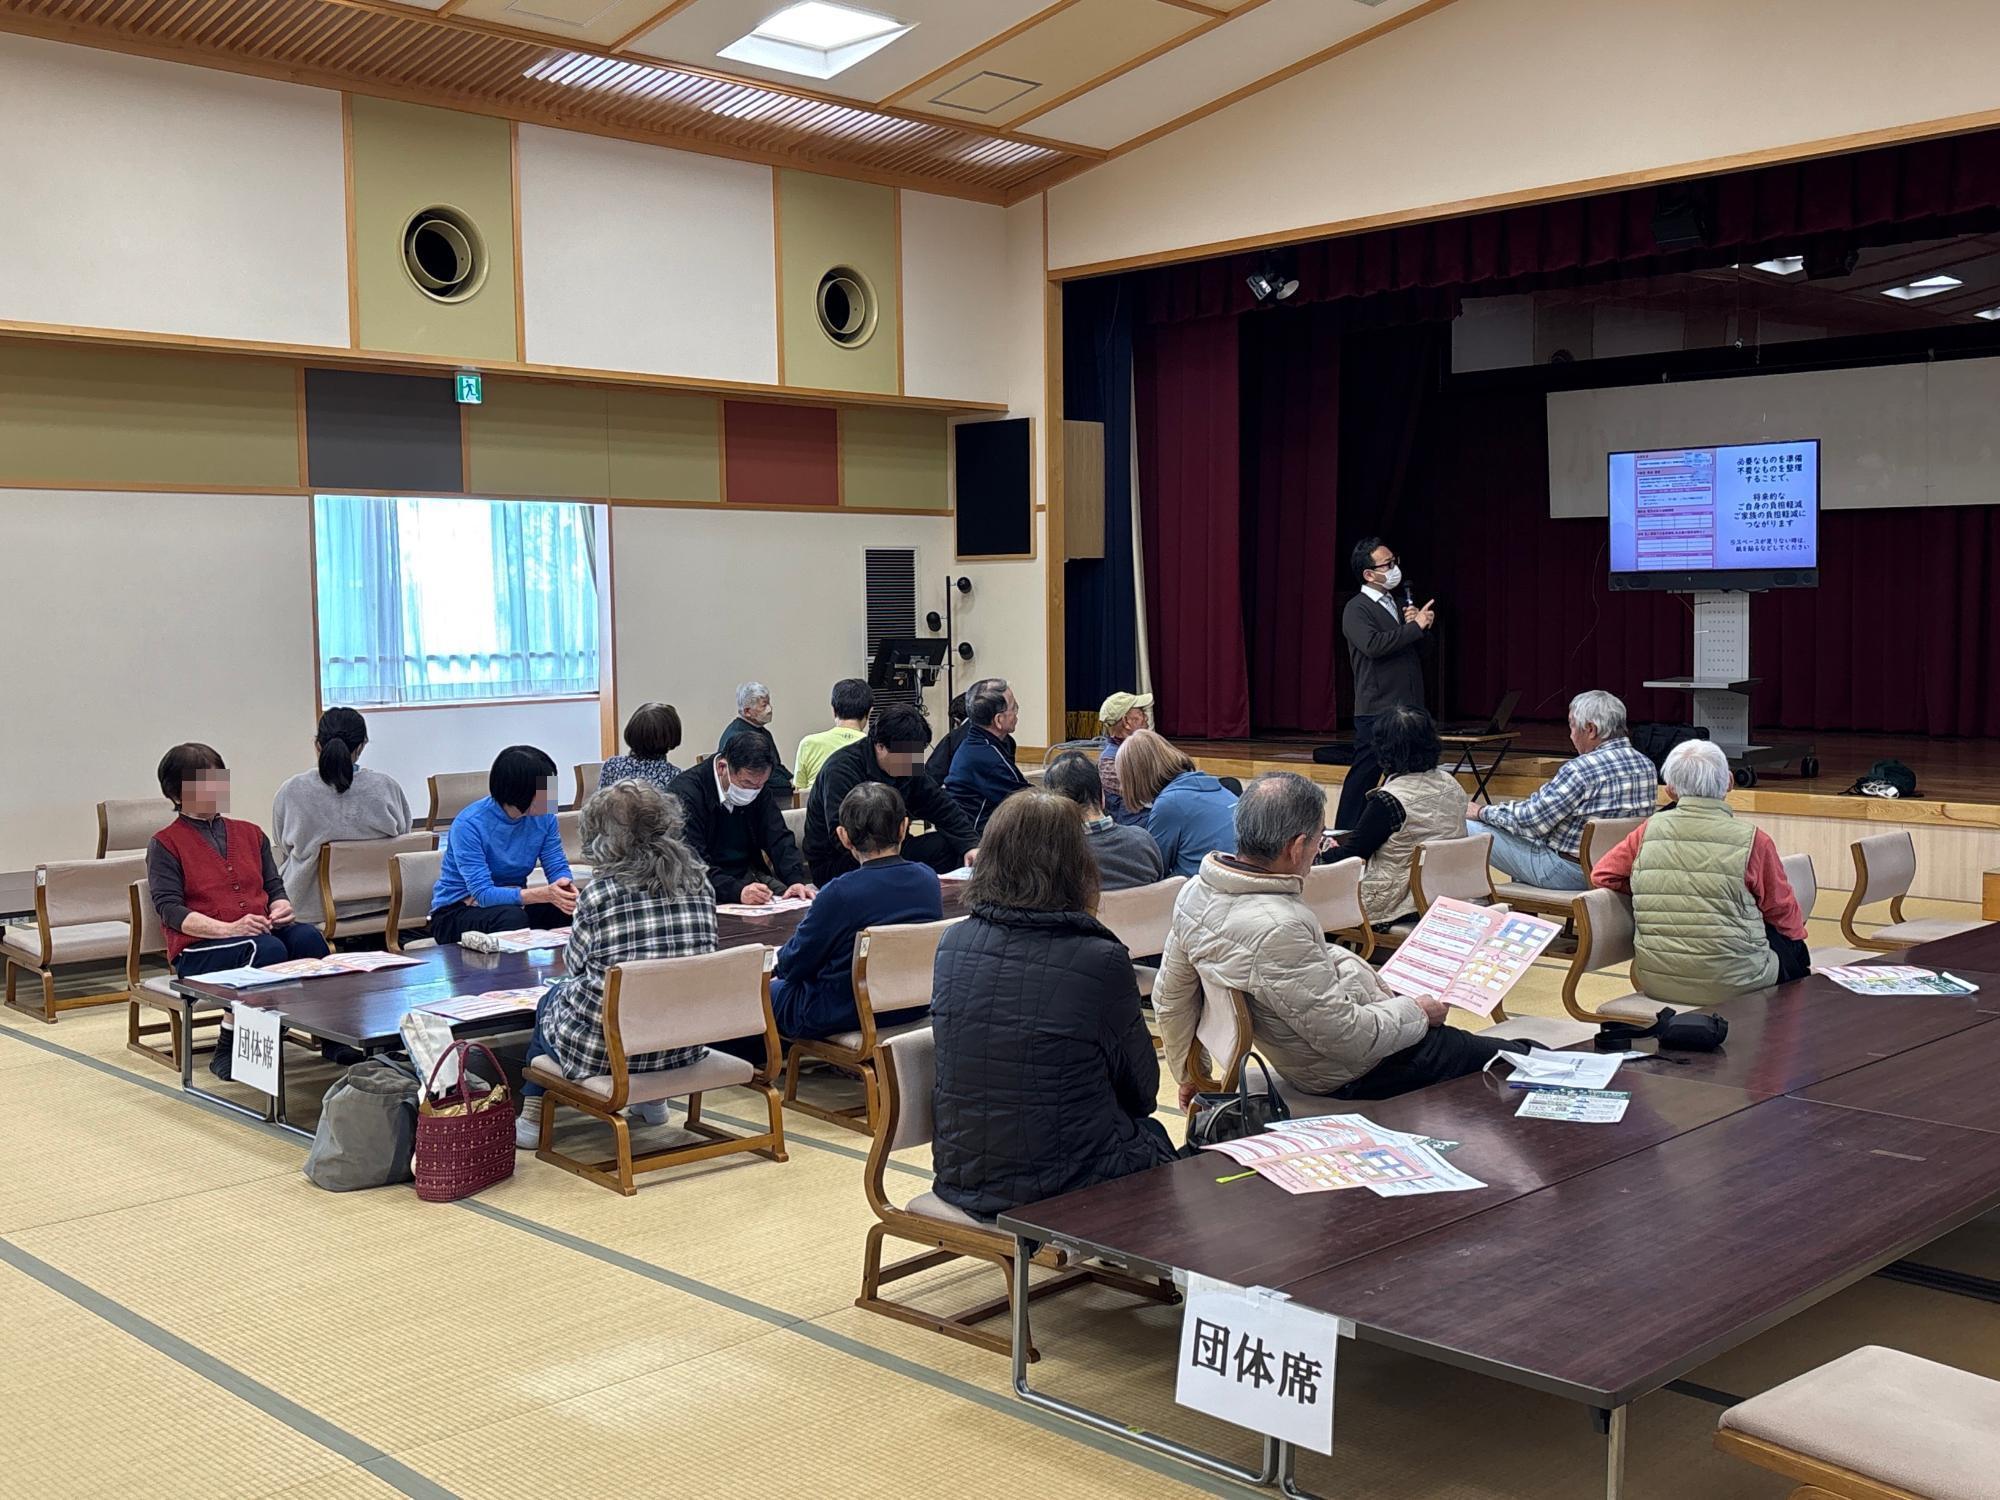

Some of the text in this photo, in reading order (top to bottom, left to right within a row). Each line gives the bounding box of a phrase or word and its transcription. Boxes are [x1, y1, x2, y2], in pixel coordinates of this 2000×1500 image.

[1736, 454, 1802, 466] 必要なものを準備
[1737, 463, 1802, 475] 不要なものを整理
[1753, 492, 1785, 501] 将来的な
[1738, 500, 1803, 510] ご自身の負担軽減
[1734, 510, 1806, 520] ご家族の負担軽減に
[1745, 519, 1794, 528] つながります
[238, 1025, 274, 1069] 団体席
[1191, 1317, 1323, 1405] 団体席
